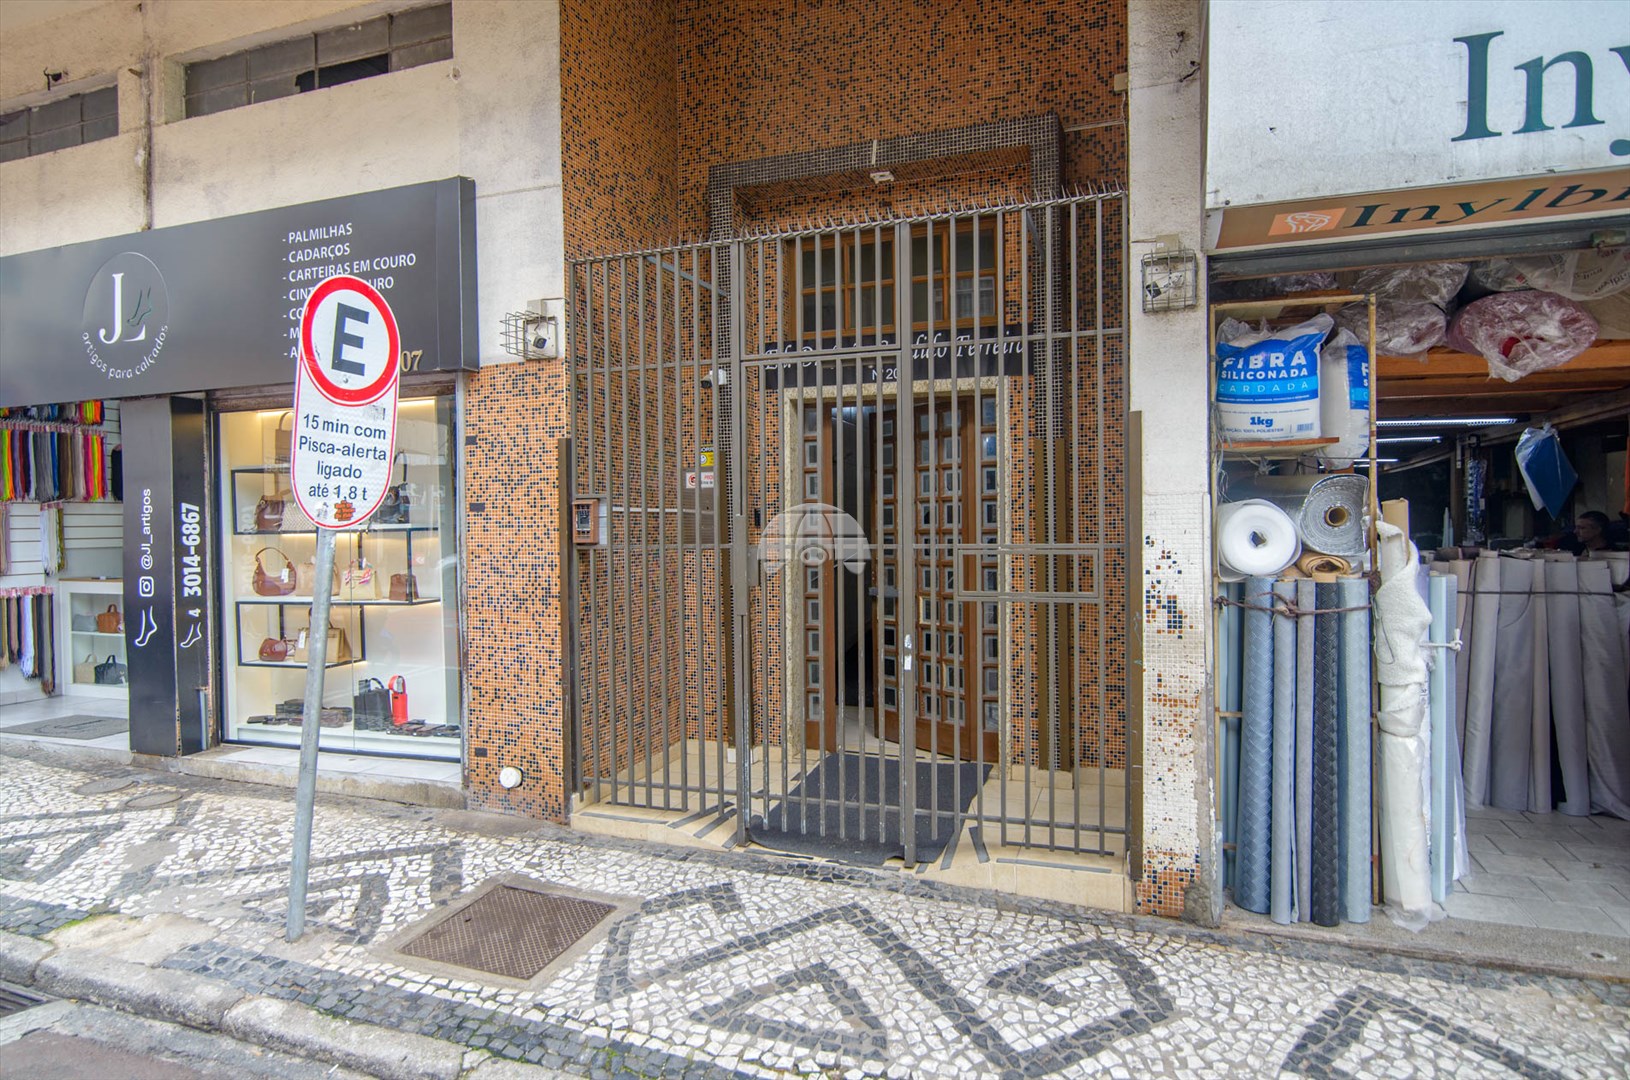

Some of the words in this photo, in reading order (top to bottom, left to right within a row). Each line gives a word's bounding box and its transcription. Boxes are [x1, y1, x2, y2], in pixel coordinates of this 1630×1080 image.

[288, 222, 353, 244] PALMILHAS
[288, 243, 351, 263] CADARÇOS
[288, 262, 351, 282] CARTEIRAS
[353, 260, 371, 273] EM
[373, 253, 417, 270] COURO
[332, 302, 370, 377] E
[81, 332, 108, 373] artigos
[108, 367, 133, 379] para
[135, 325, 169, 375] calçados
[1222, 350, 1307, 369] FIBRA
[1221, 368, 1308, 380] SILICONADA
[1219, 381, 1309, 393] CARDADA
[303, 413, 319, 430] 15
[322, 418, 349, 434] min
[354, 424, 387, 440] com
[1249, 416, 1274, 428] 1kg
[299, 435, 387, 461] Pisca-alerta
[317, 460, 363, 480] ligado
[308, 483, 329, 498] até
[333, 484, 358, 500] 1,8
[362, 487, 368, 500] t
[181, 502, 202, 597] 3014-6867
